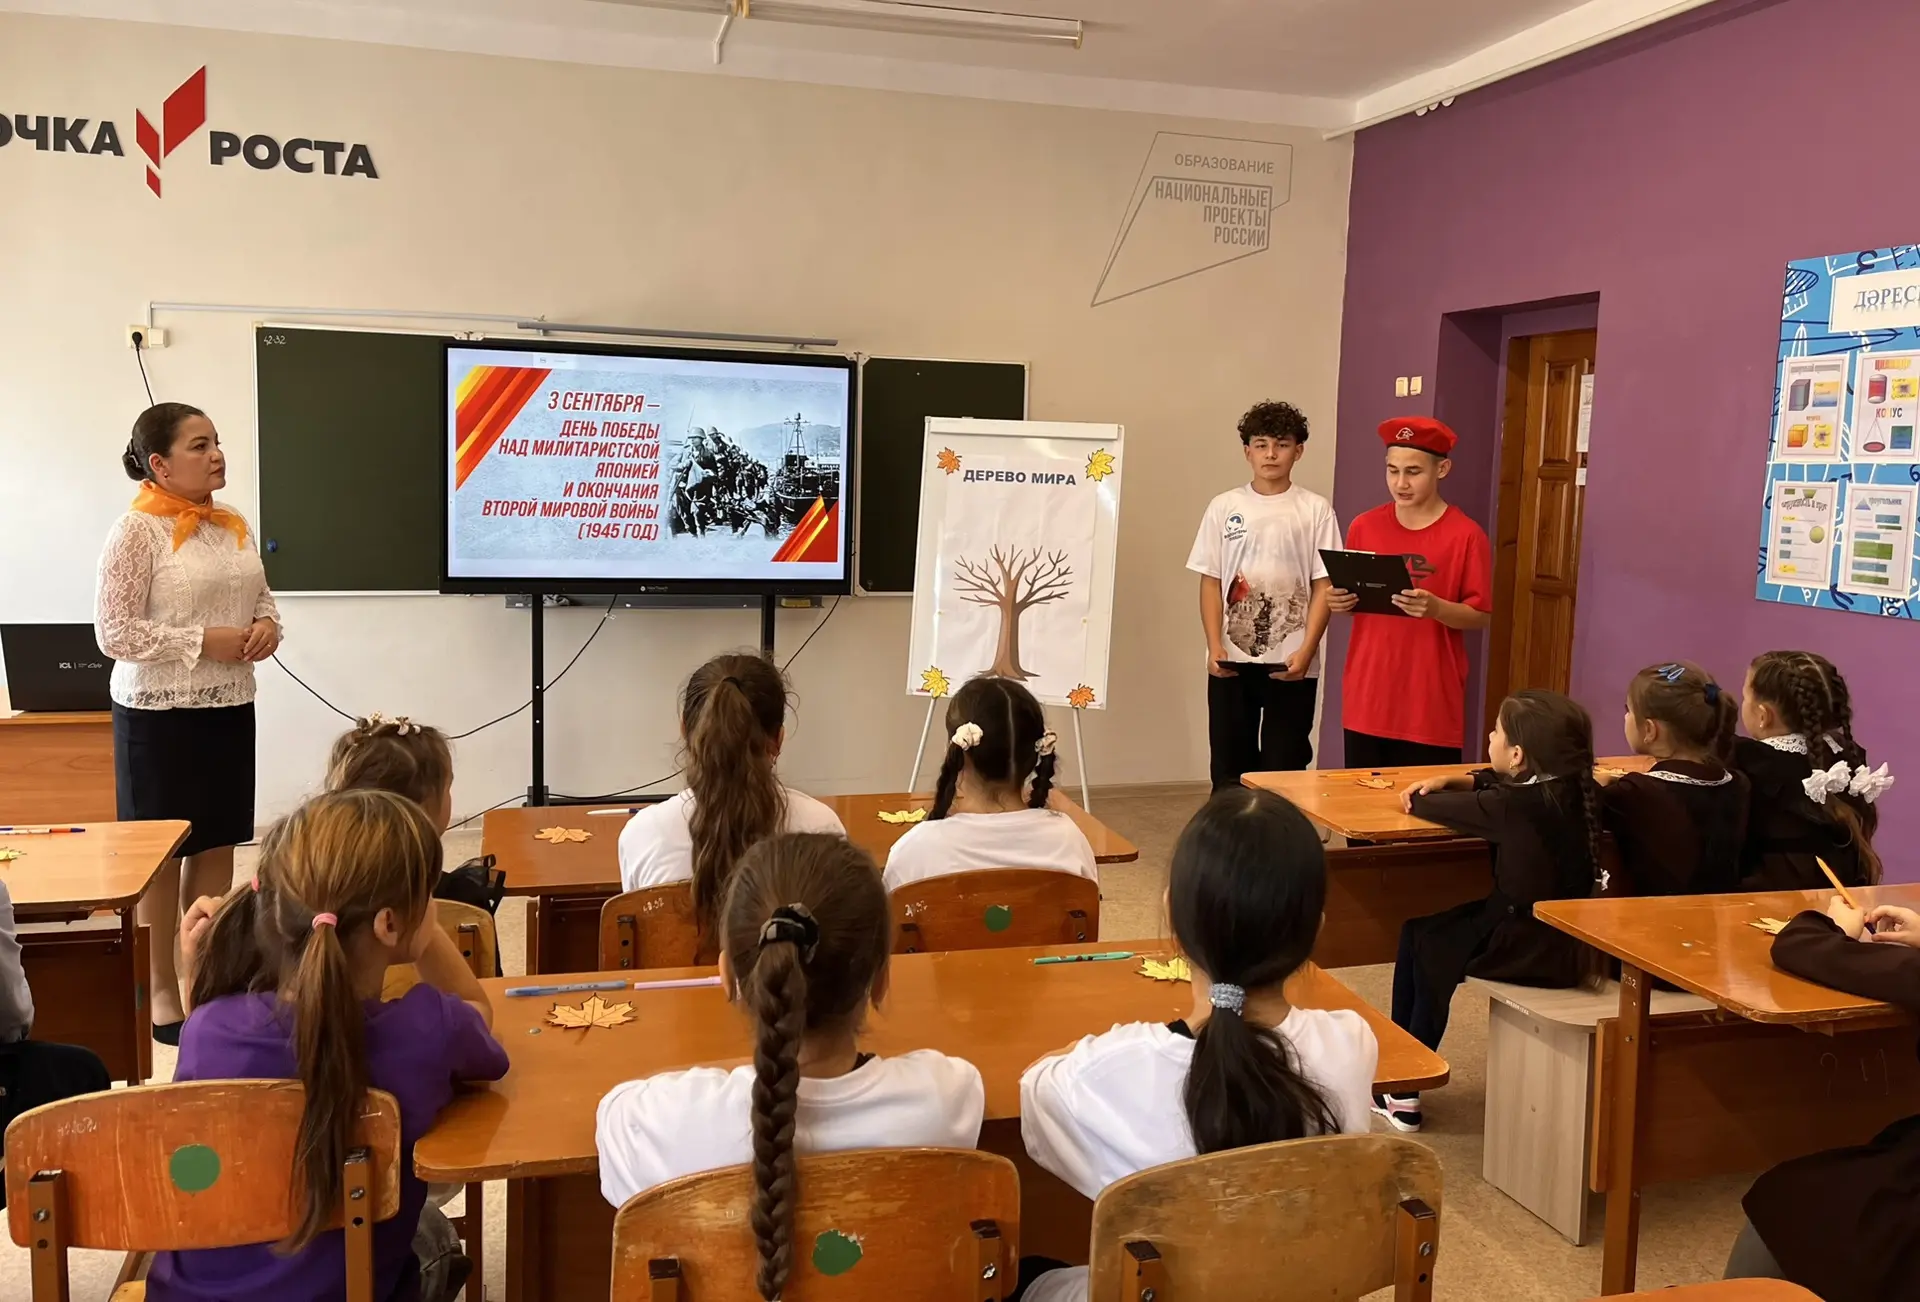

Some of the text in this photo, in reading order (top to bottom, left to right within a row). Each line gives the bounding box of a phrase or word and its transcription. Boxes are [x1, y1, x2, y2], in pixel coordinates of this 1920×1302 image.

[209, 130, 379, 179] РОСТА
[1174, 153, 1275, 175] ОБРАЗОВАНИЕ
[1155, 180, 1268, 208] НАЦИОНАЛЬНЫЕ
[1203, 205, 1267, 227] ПРОЕКТЫ
[1214, 226, 1266, 247] РОССИИ
[1854, 284, 1920, 308] ДӘРЕС
[548, 391, 559, 410] 3
[562, 391, 645, 413] СЕНТЯБРЯ
[559, 420, 660, 440] ДЕНЬ ПОБЕДЫ
[498, 438, 660, 460] НАД МИЛИТАРИСТСКОЙ
[595, 460, 660, 479] ЯПОНИЕЙ
[963, 469, 1077, 486] ДЕРЕВО МИРА
[563, 482, 659, 499] И ОКОНЧАНИЯ
[482, 497, 659, 520] ВТОРОЙ МИРОВОЙ ВОЙНЫ
[578, 522, 659, 541] (1945 ГОД)
